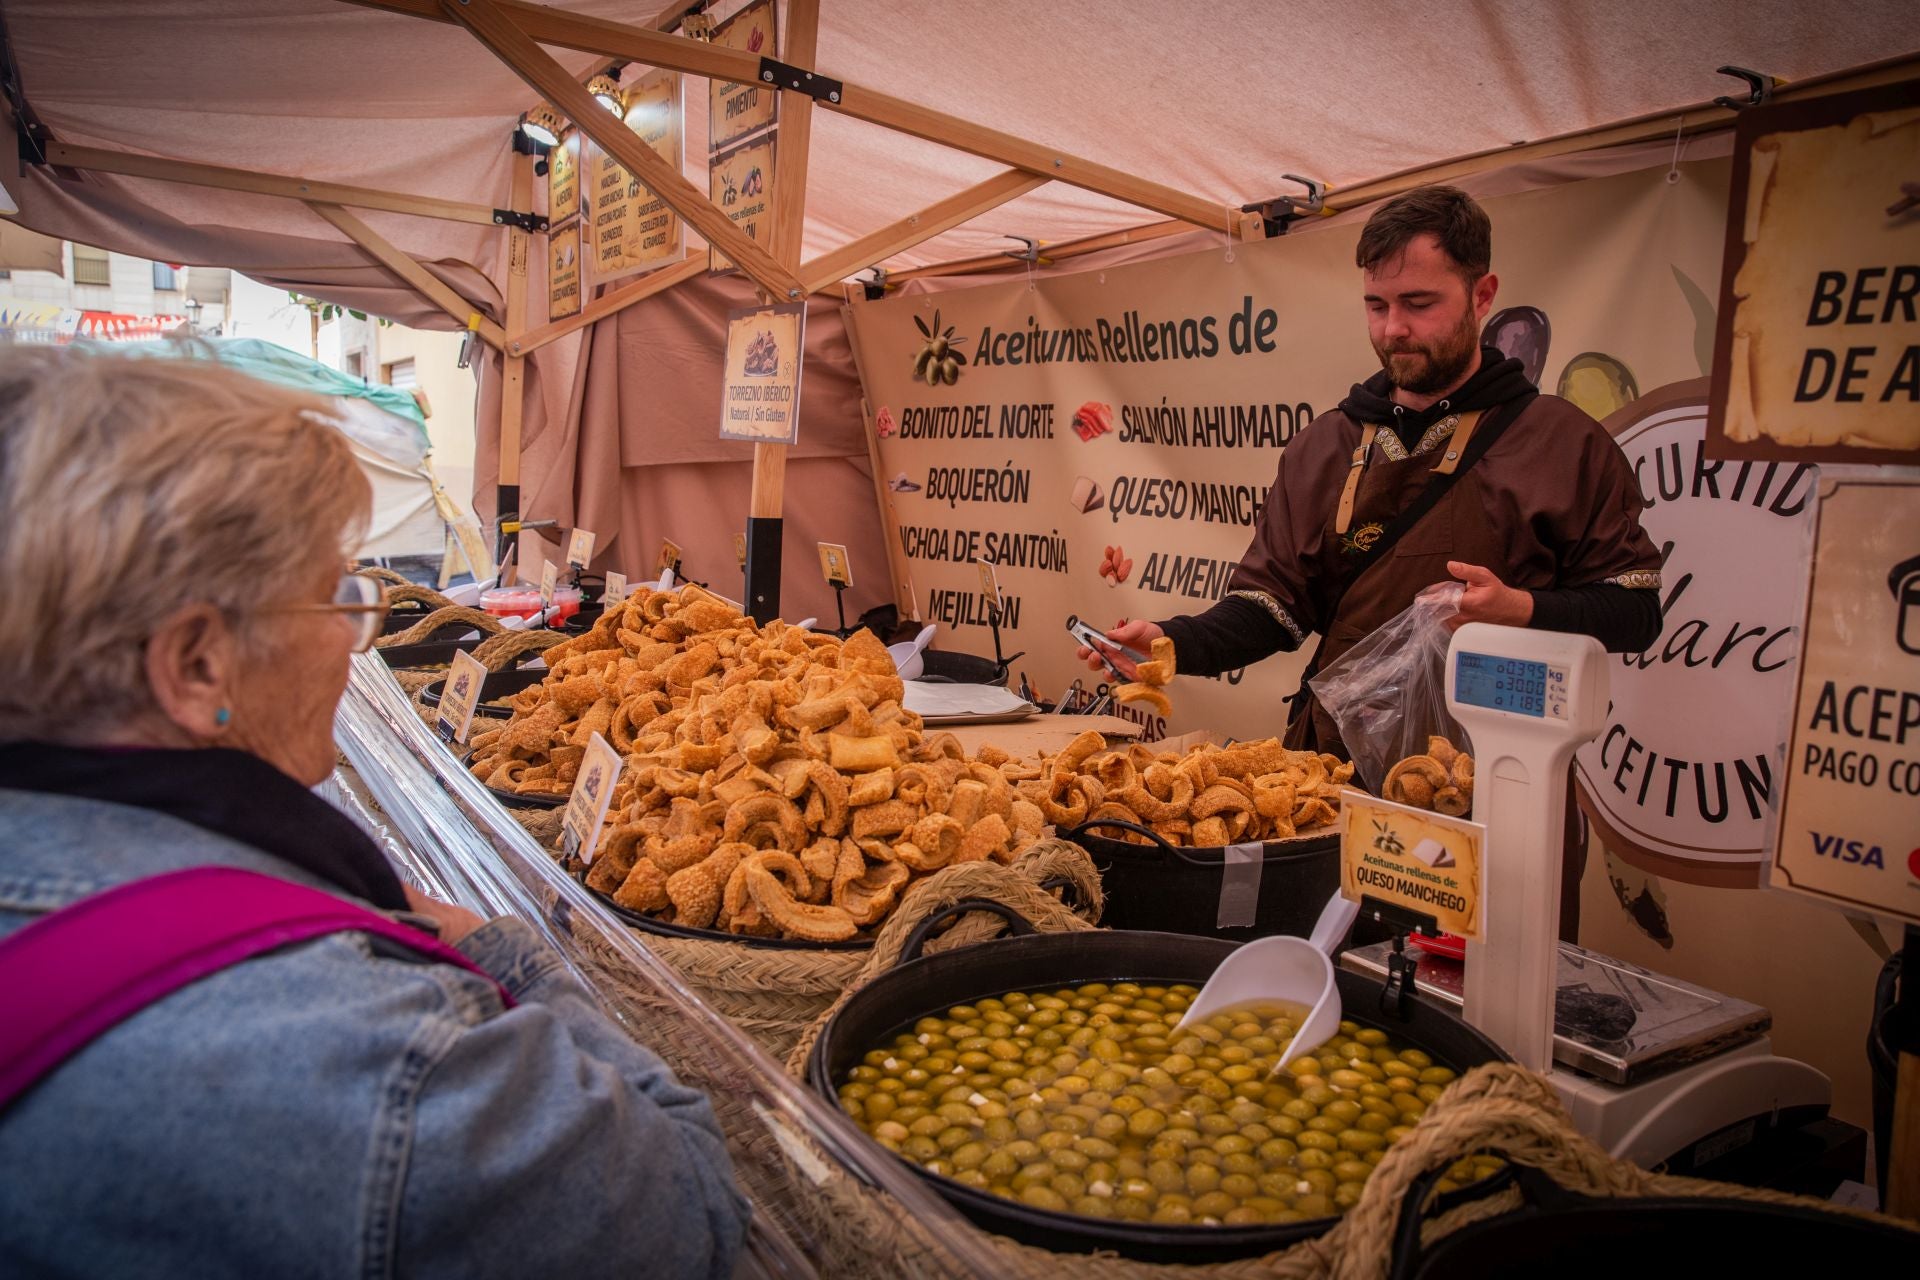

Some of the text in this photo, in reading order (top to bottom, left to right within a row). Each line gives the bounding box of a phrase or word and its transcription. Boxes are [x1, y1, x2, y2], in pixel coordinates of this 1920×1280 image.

[726, 87, 757, 120] PIMIENTO
[973, 296, 1279, 367] Aceitunas Rellenas de
[729, 381, 791, 402] TORREZNO IBÉRICO
[1794, 346, 1877, 402] DE
[730, 407, 750, 421] Natural
[755, 405, 765, 421] Sin
[766, 407, 785, 422] Gluten
[900, 404, 1054, 439] BONITO DEL NORTE
[1119, 397, 1188, 446] SALMÓN
[926, 460, 1030, 509] BOQUERÓN
[1109, 476, 1272, 527] QUESO MANCH
[953, 530, 980, 563] DE
[984, 529, 1068, 573] SANTOÑA
[1549, 669, 1563, 682] kg
[1803, 743, 1878, 787] PAGO
[1363, 853, 1458, 889] Aceitunas rellenas de:
[1807, 830, 1884, 870] VISA
[1357, 866, 1466, 913] QUESO MANCHEGO
